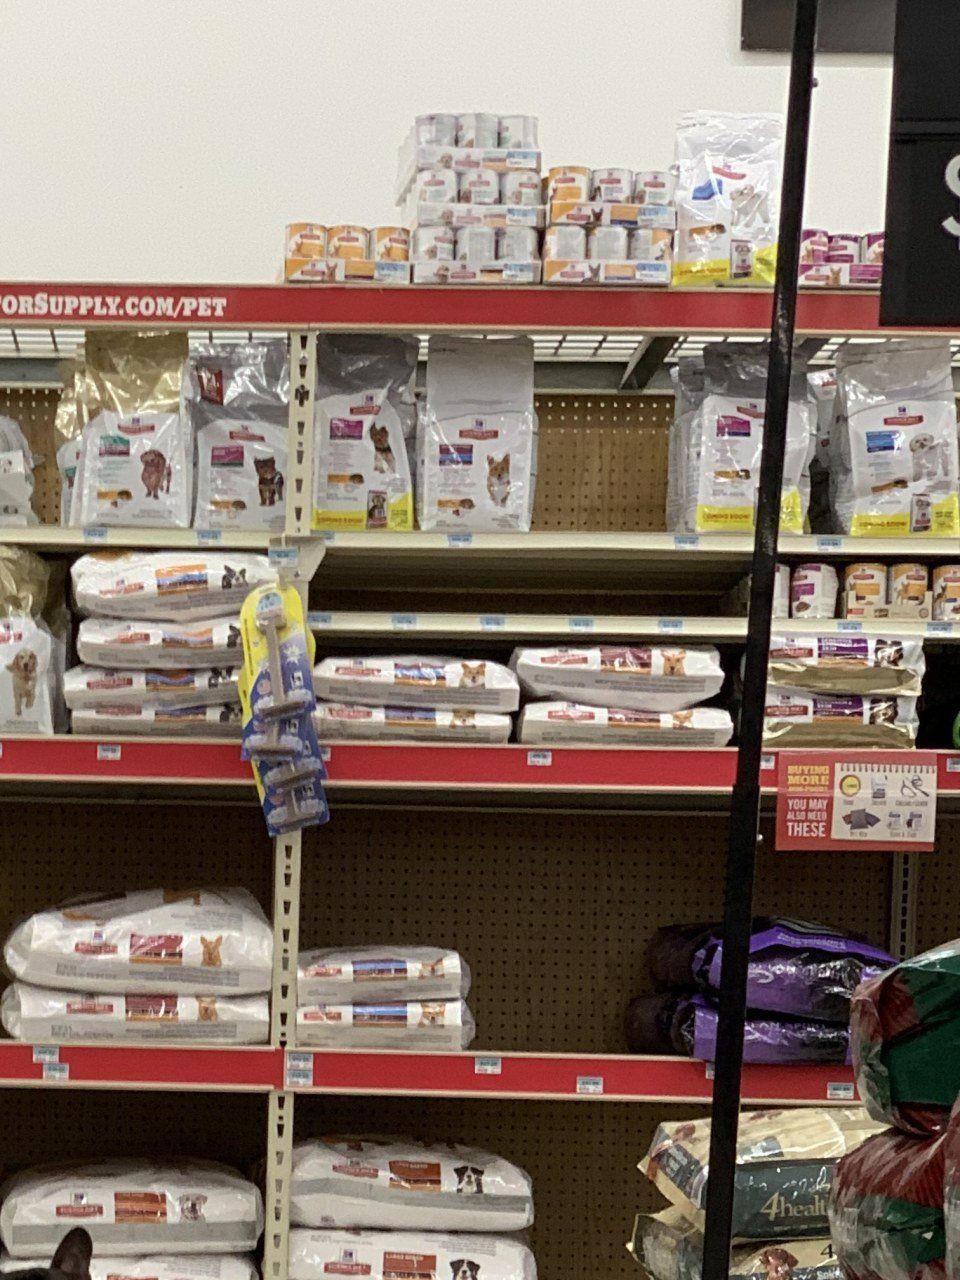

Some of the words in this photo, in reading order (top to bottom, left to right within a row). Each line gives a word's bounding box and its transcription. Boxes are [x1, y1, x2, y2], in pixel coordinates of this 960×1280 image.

[787, 775, 829, 785] MORE
[787, 799, 807, 810] YOU
[809, 799, 828, 810] MAY
[787, 811, 806, 821] ALSO
[807, 812, 827, 821] NEED
[787, 822, 826, 837] THESE
